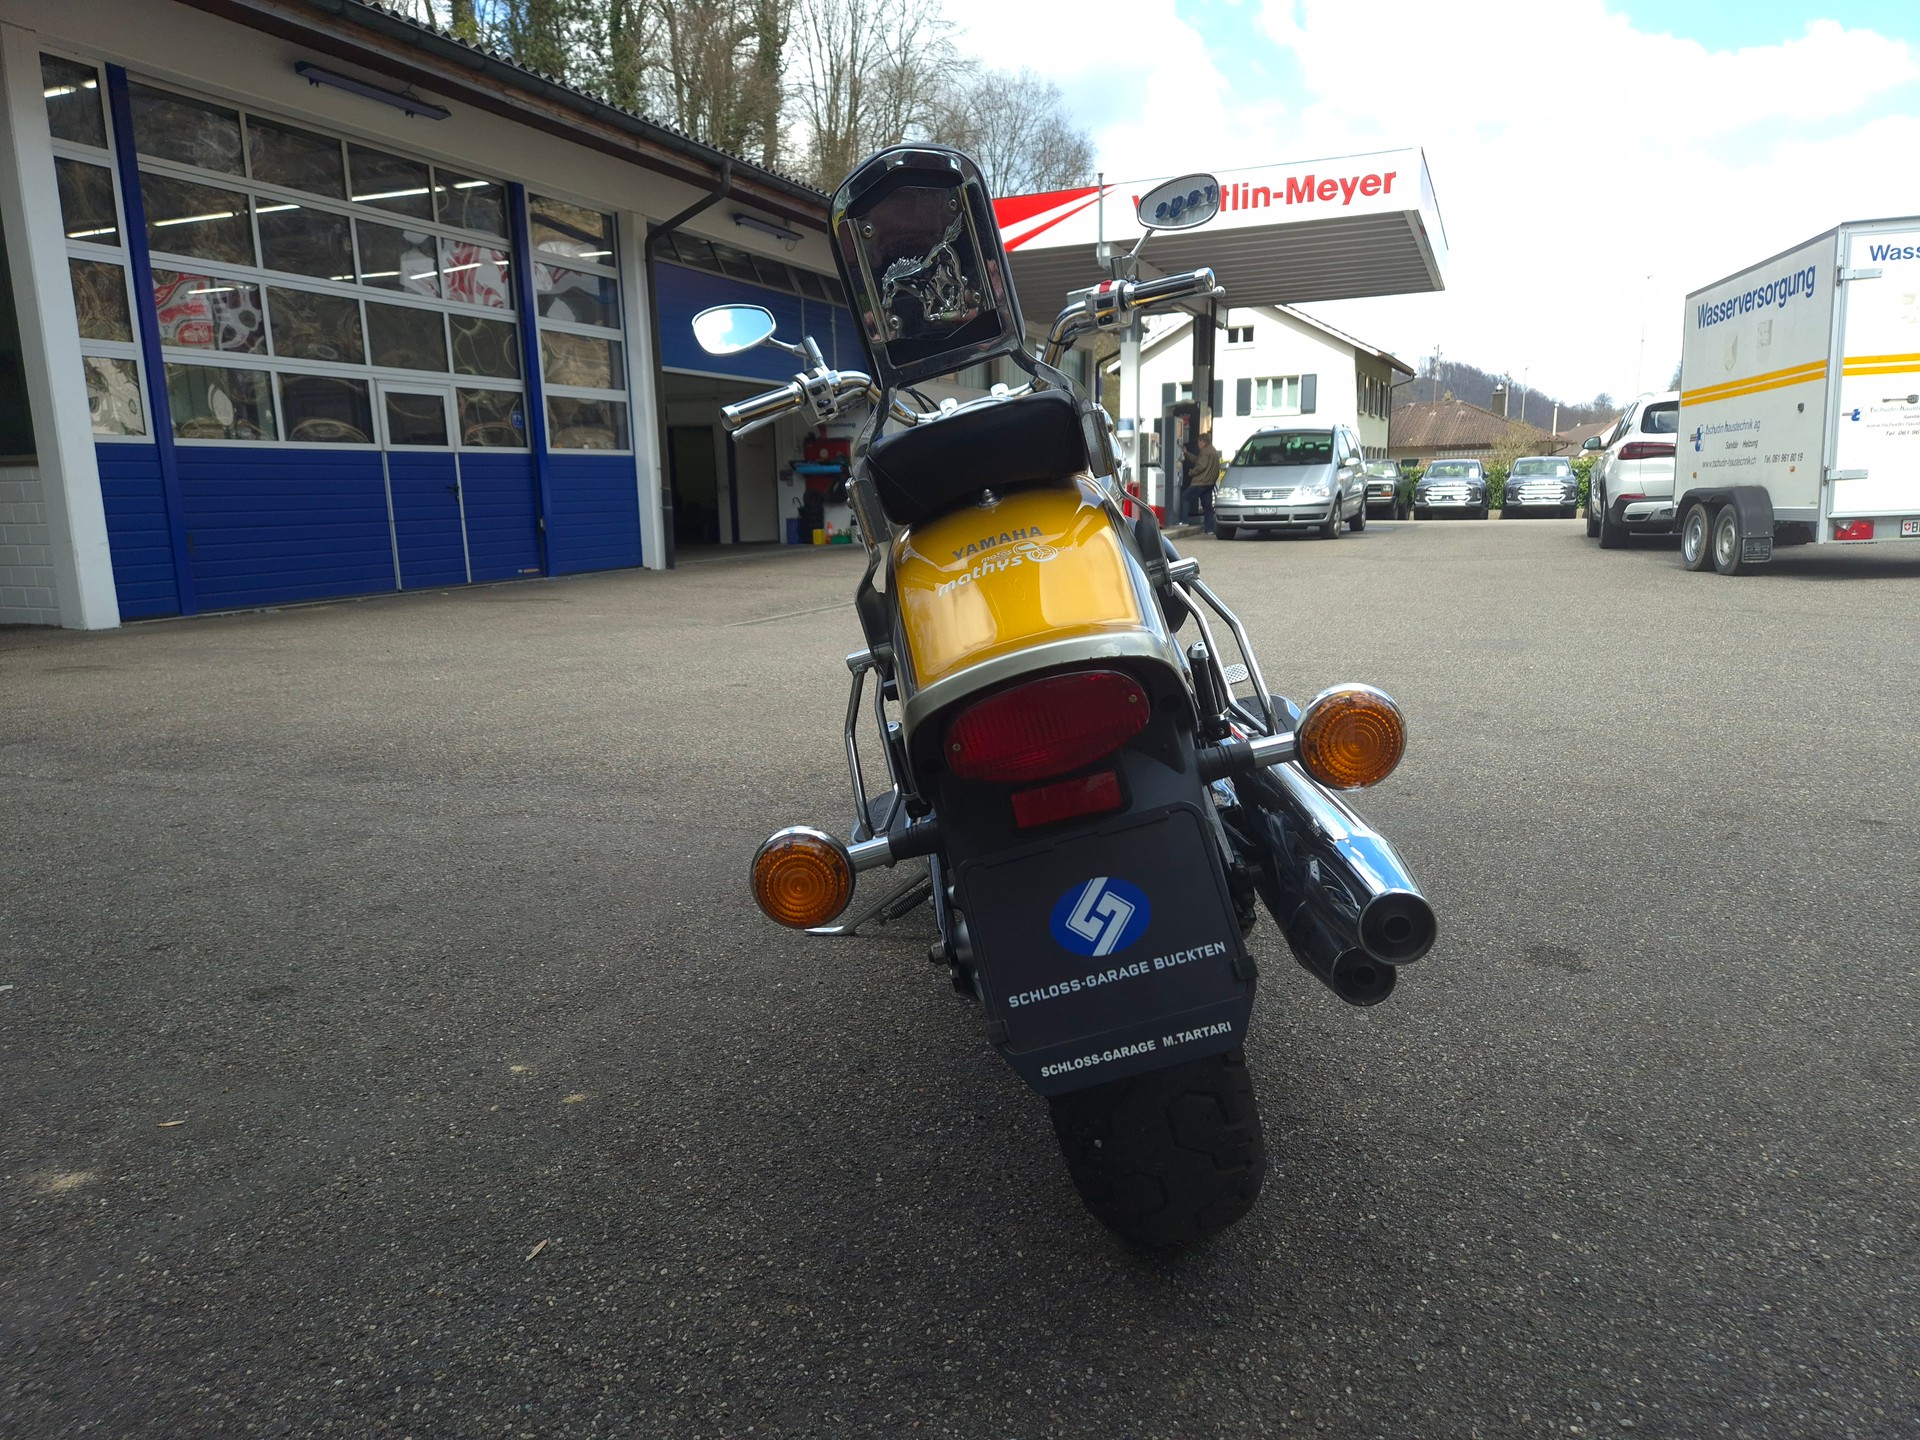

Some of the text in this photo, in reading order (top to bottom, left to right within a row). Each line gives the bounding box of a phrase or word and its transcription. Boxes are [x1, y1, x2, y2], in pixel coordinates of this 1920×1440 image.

[1697, 265, 1816, 329] Wasserversorgung
[1724, 418, 1753, 433] haustechnik
[1754, 420, 1761, 433] ag
[1772, 454, 1780, 463] 061
[1780, 453, 1789, 463] 961
[1790, 452, 1797, 462] 80
[1798, 452, 1803, 462] 19
[952, 526, 1043, 560] YAMAHA
[981, 550, 1012, 563] motos
[938, 556, 1024, 597] mathys
[1008, 941, 1226, 1008] SCHLOSS-GARAGE BUCKTEN
[1041, 1021, 1232, 1077] SCHLOSS-GARAGE M.TARTARI
